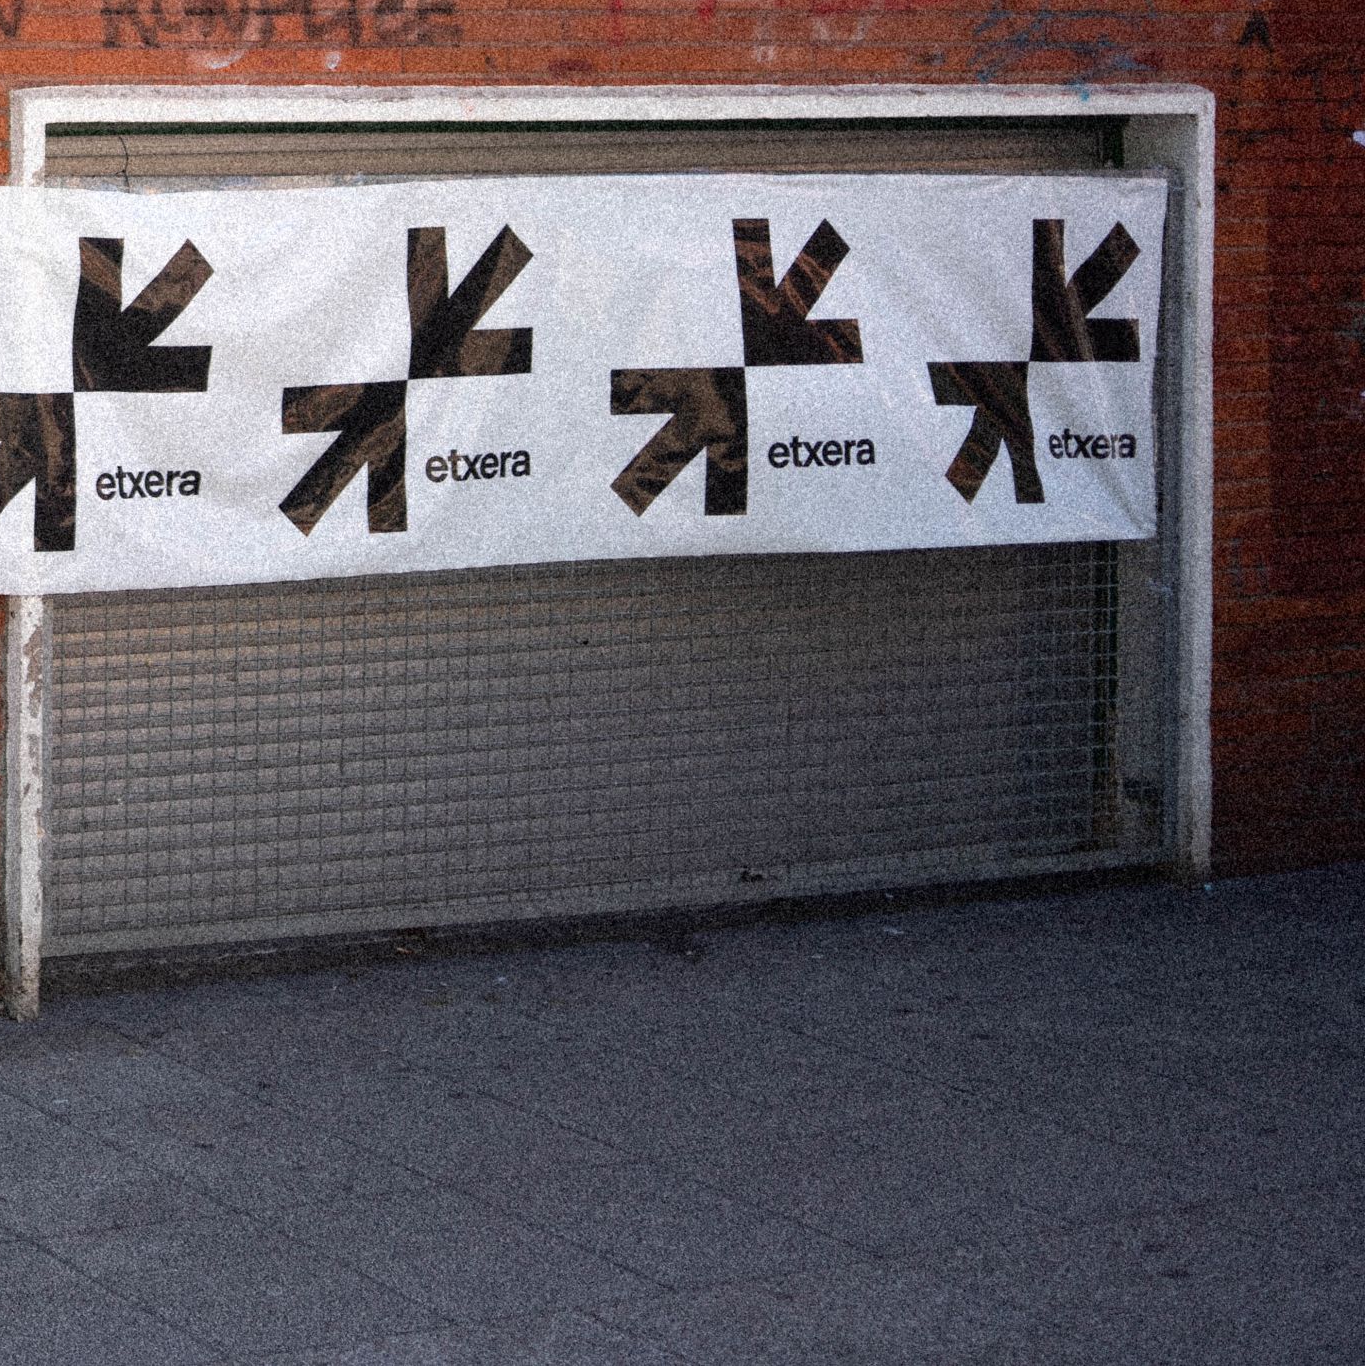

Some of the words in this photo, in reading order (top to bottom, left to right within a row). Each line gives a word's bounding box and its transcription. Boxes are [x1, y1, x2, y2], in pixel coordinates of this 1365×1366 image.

[767, 434, 876, 470] etxera
[1048, 428, 1137, 461] etxera
[95, 466, 201, 501] etxera
[425, 448, 532, 484] etxera
